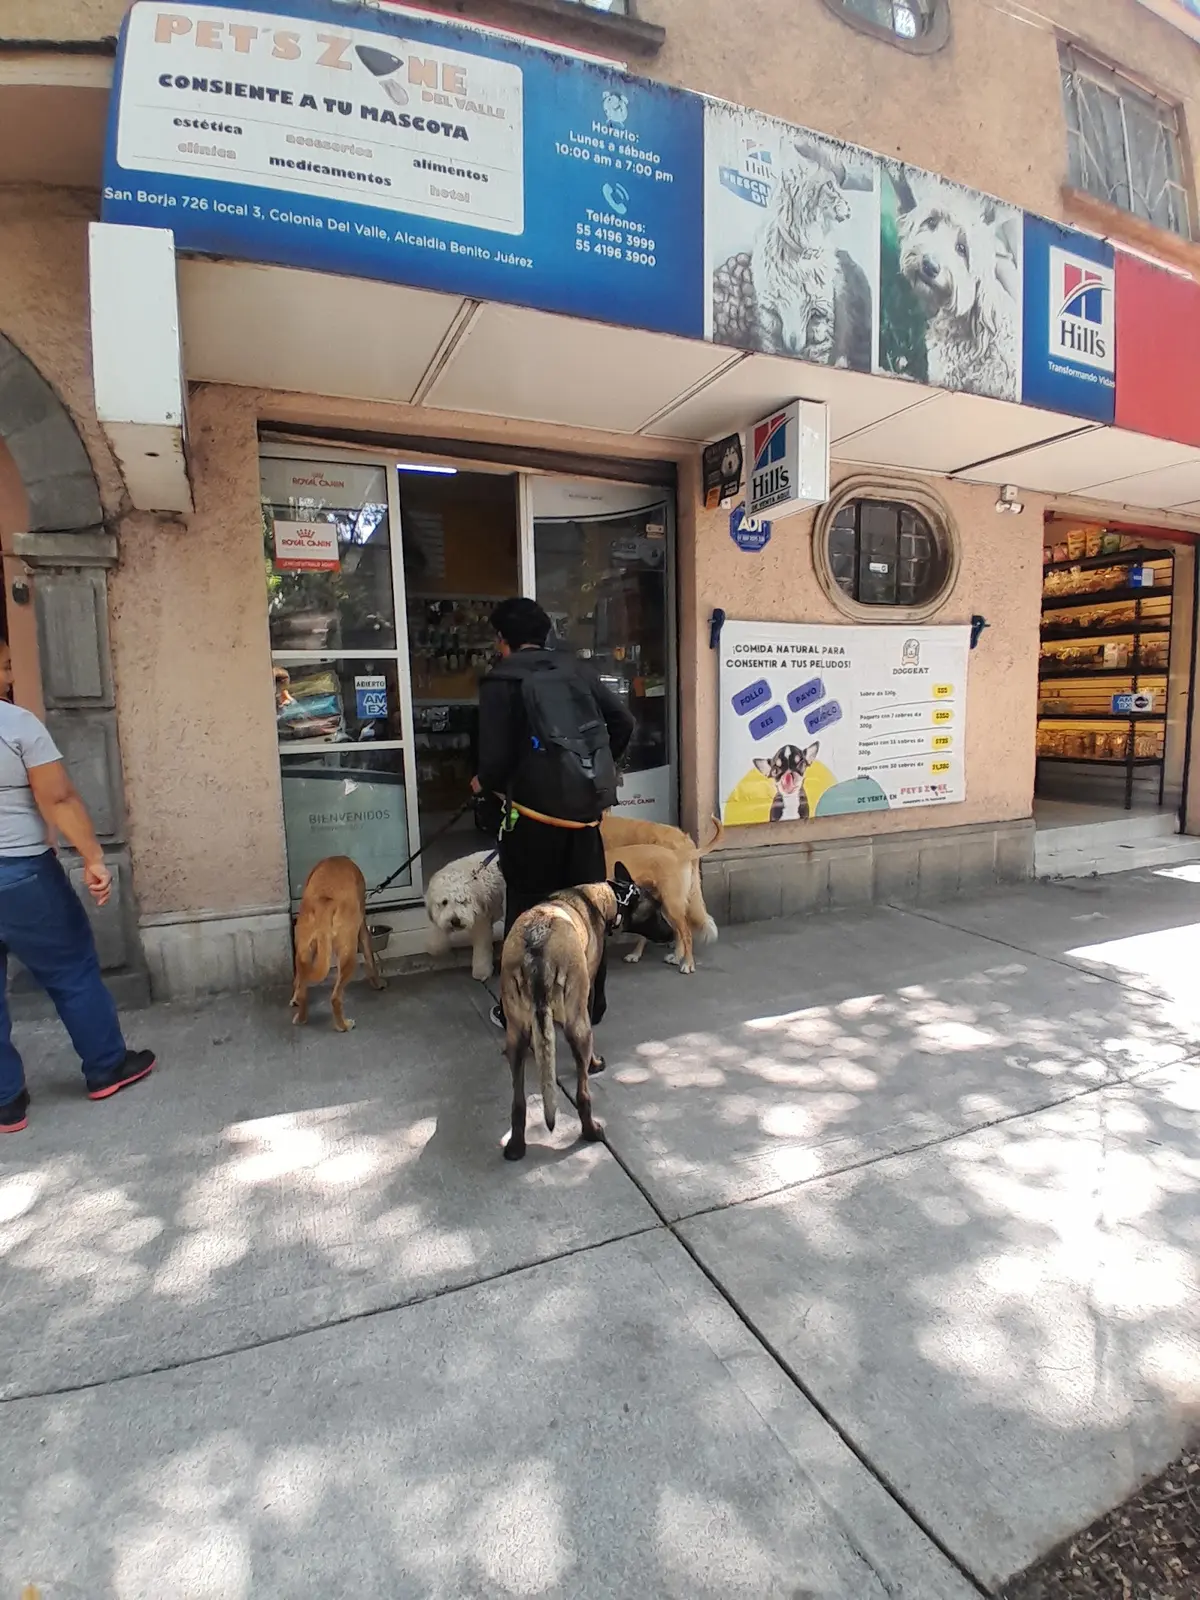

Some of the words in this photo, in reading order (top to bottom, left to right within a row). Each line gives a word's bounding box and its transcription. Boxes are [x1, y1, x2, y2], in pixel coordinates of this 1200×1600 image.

[158, 73, 293, 105] CONSIENTE
[299, 94, 317, 110] A
[323, 98, 353, 116] TU
[360, 105, 470, 142] MASCOTA
[422, 91, 453, 108] DEL
[455, 97, 506, 120] VALLE
[172, 117, 243, 135] estética
[591, 120, 640, 143] Horario:
[285, 133, 373, 158] accesorios
[569, 130, 605, 150] Lunes
[608, 142, 616, 152] a
[618, 144, 661, 164] sábado
[268, 155, 392, 187] medicamentos
[412, 158, 489, 183] alimentos
[554, 142, 590, 160] 10:00
[593, 154, 612, 167] am
[615, 160, 622, 169] a
[625, 160, 653, 177] 7:00
[655, 170, 674, 183] pm
[429, 184, 471, 203] hotel
[104, 186, 133, 201] San
[137, 190, 177, 207] Borja
[181, 195, 209, 210] 726
[213, 199, 248, 216] local
[252, 206, 265, 220] 3,
[269, 208, 323, 229] Colonia
[327, 218, 350, 233] Del
[353, 222, 390, 242] Valle,
[450, 241, 491, 260] Benito
[494, 250, 534, 269] Juárez
[585, 208, 647, 234] Teléfonos:
[576, 222, 591, 237] 55
[594, 228, 623, 244] 4196
[626, 234, 656, 251] 3999
[575, 239, 591, 253] 55
[594, 243, 622, 260] 4196
[625, 249, 657, 267] 3900
[1060, 319, 1106, 358] Hill's
[1048, 360, 1098, 383] Transformando
[292, 477, 318, 487] ROYAL
[318, 479, 345, 488] CANIN
[752, 465, 790, 500] Hill's
[281, 538, 305, 547] ROYAL
[306, 539, 332, 548] CANIN
[776, 644, 820, 654] NATURAL
[822, 646, 845, 655] PARA
[726, 659, 777, 668] CONSENTIR
[780, 659, 788, 668] A
[791, 659, 807, 668] TUS
[810, 660, 851, 669] PELUDOS!
[356, 680, 385, 688] ABIERTO
[795, 687, 817, 704] PAVO
[760, 716, 774, 728] RES
[859, 713, 880, 721] Paquete
[858, 740, 879, 748] Paquete
[857, 765, 878, 773] Paquete
[867, 794, 888, 803] VENTA
[889, 793, 897, 801] EN
[308, 809, 391, 825] BIENVENIDOS
